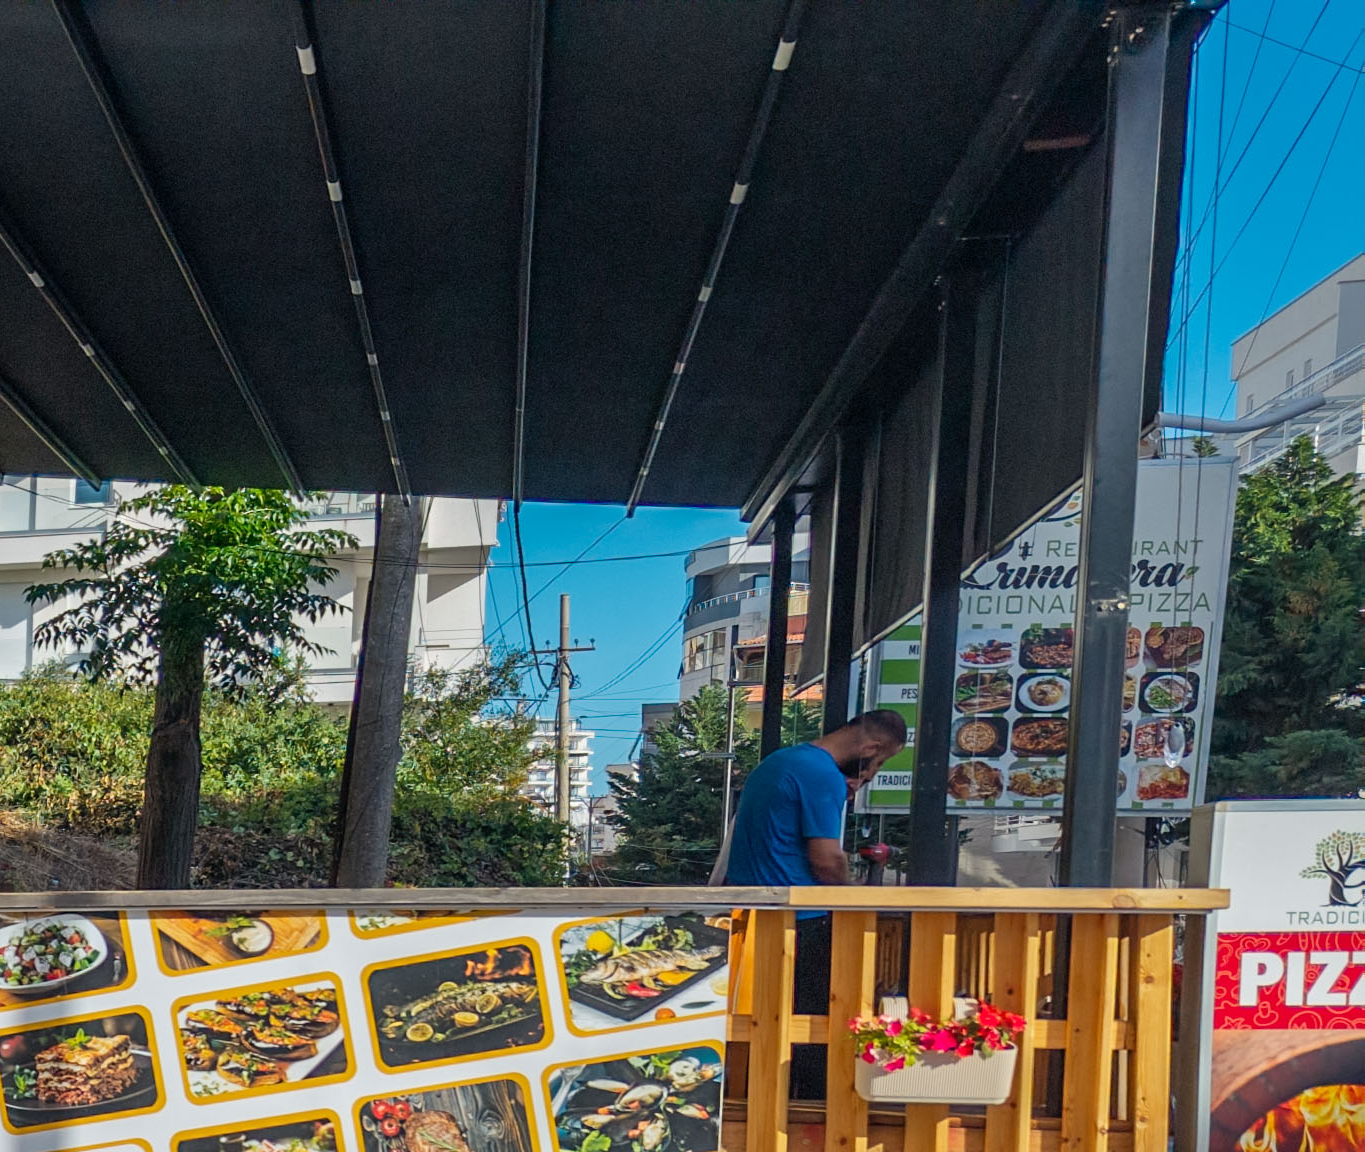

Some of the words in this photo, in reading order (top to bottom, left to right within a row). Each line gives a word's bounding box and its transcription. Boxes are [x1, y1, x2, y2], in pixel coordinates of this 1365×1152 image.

[1046, 540, 1203, 557] RERANT
[959, 594, 1077, 615] ICIONAL
[1129, 592, 1210, 612] PIZZA
[901, 688, 918, 699] PES
[877, 775, 911, 787] TRADICI
[1286, 911, 1365, 925] TRADICI
